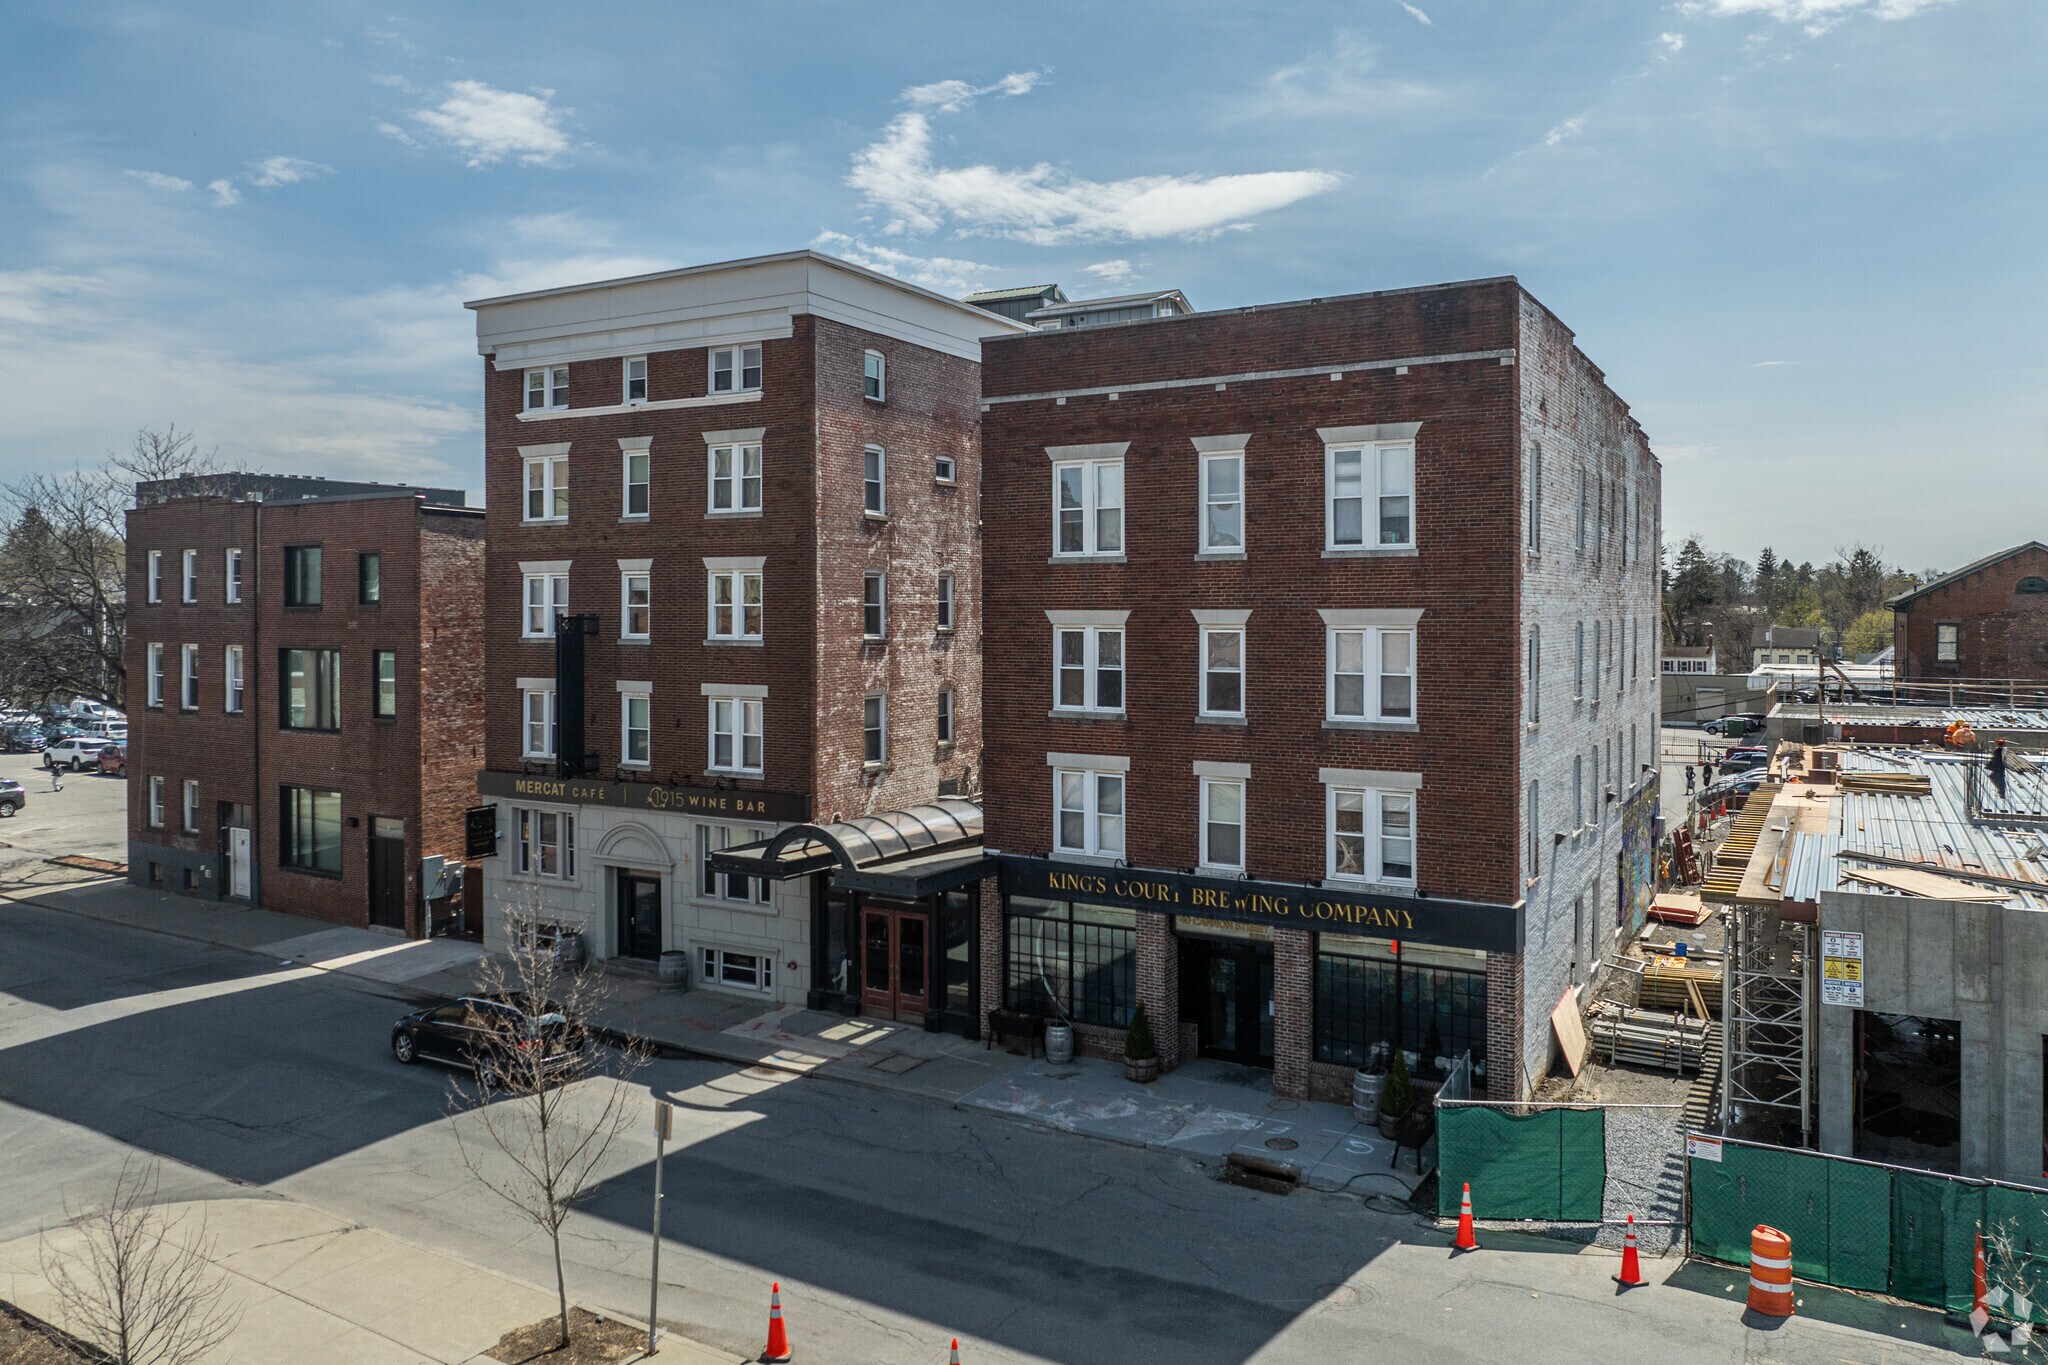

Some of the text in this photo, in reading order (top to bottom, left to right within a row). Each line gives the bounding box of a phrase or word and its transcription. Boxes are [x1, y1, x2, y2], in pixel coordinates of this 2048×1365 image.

[516, 779, 605, 799] MERCAT CAFÉ
[654, 789, 765, 813] 1915 WINE BAR
[1048, 871, 1107, 894] KING'S
[1191, 887, 1290, 916] BREWING
[1299, 901, 1415, 930] COMPANY
